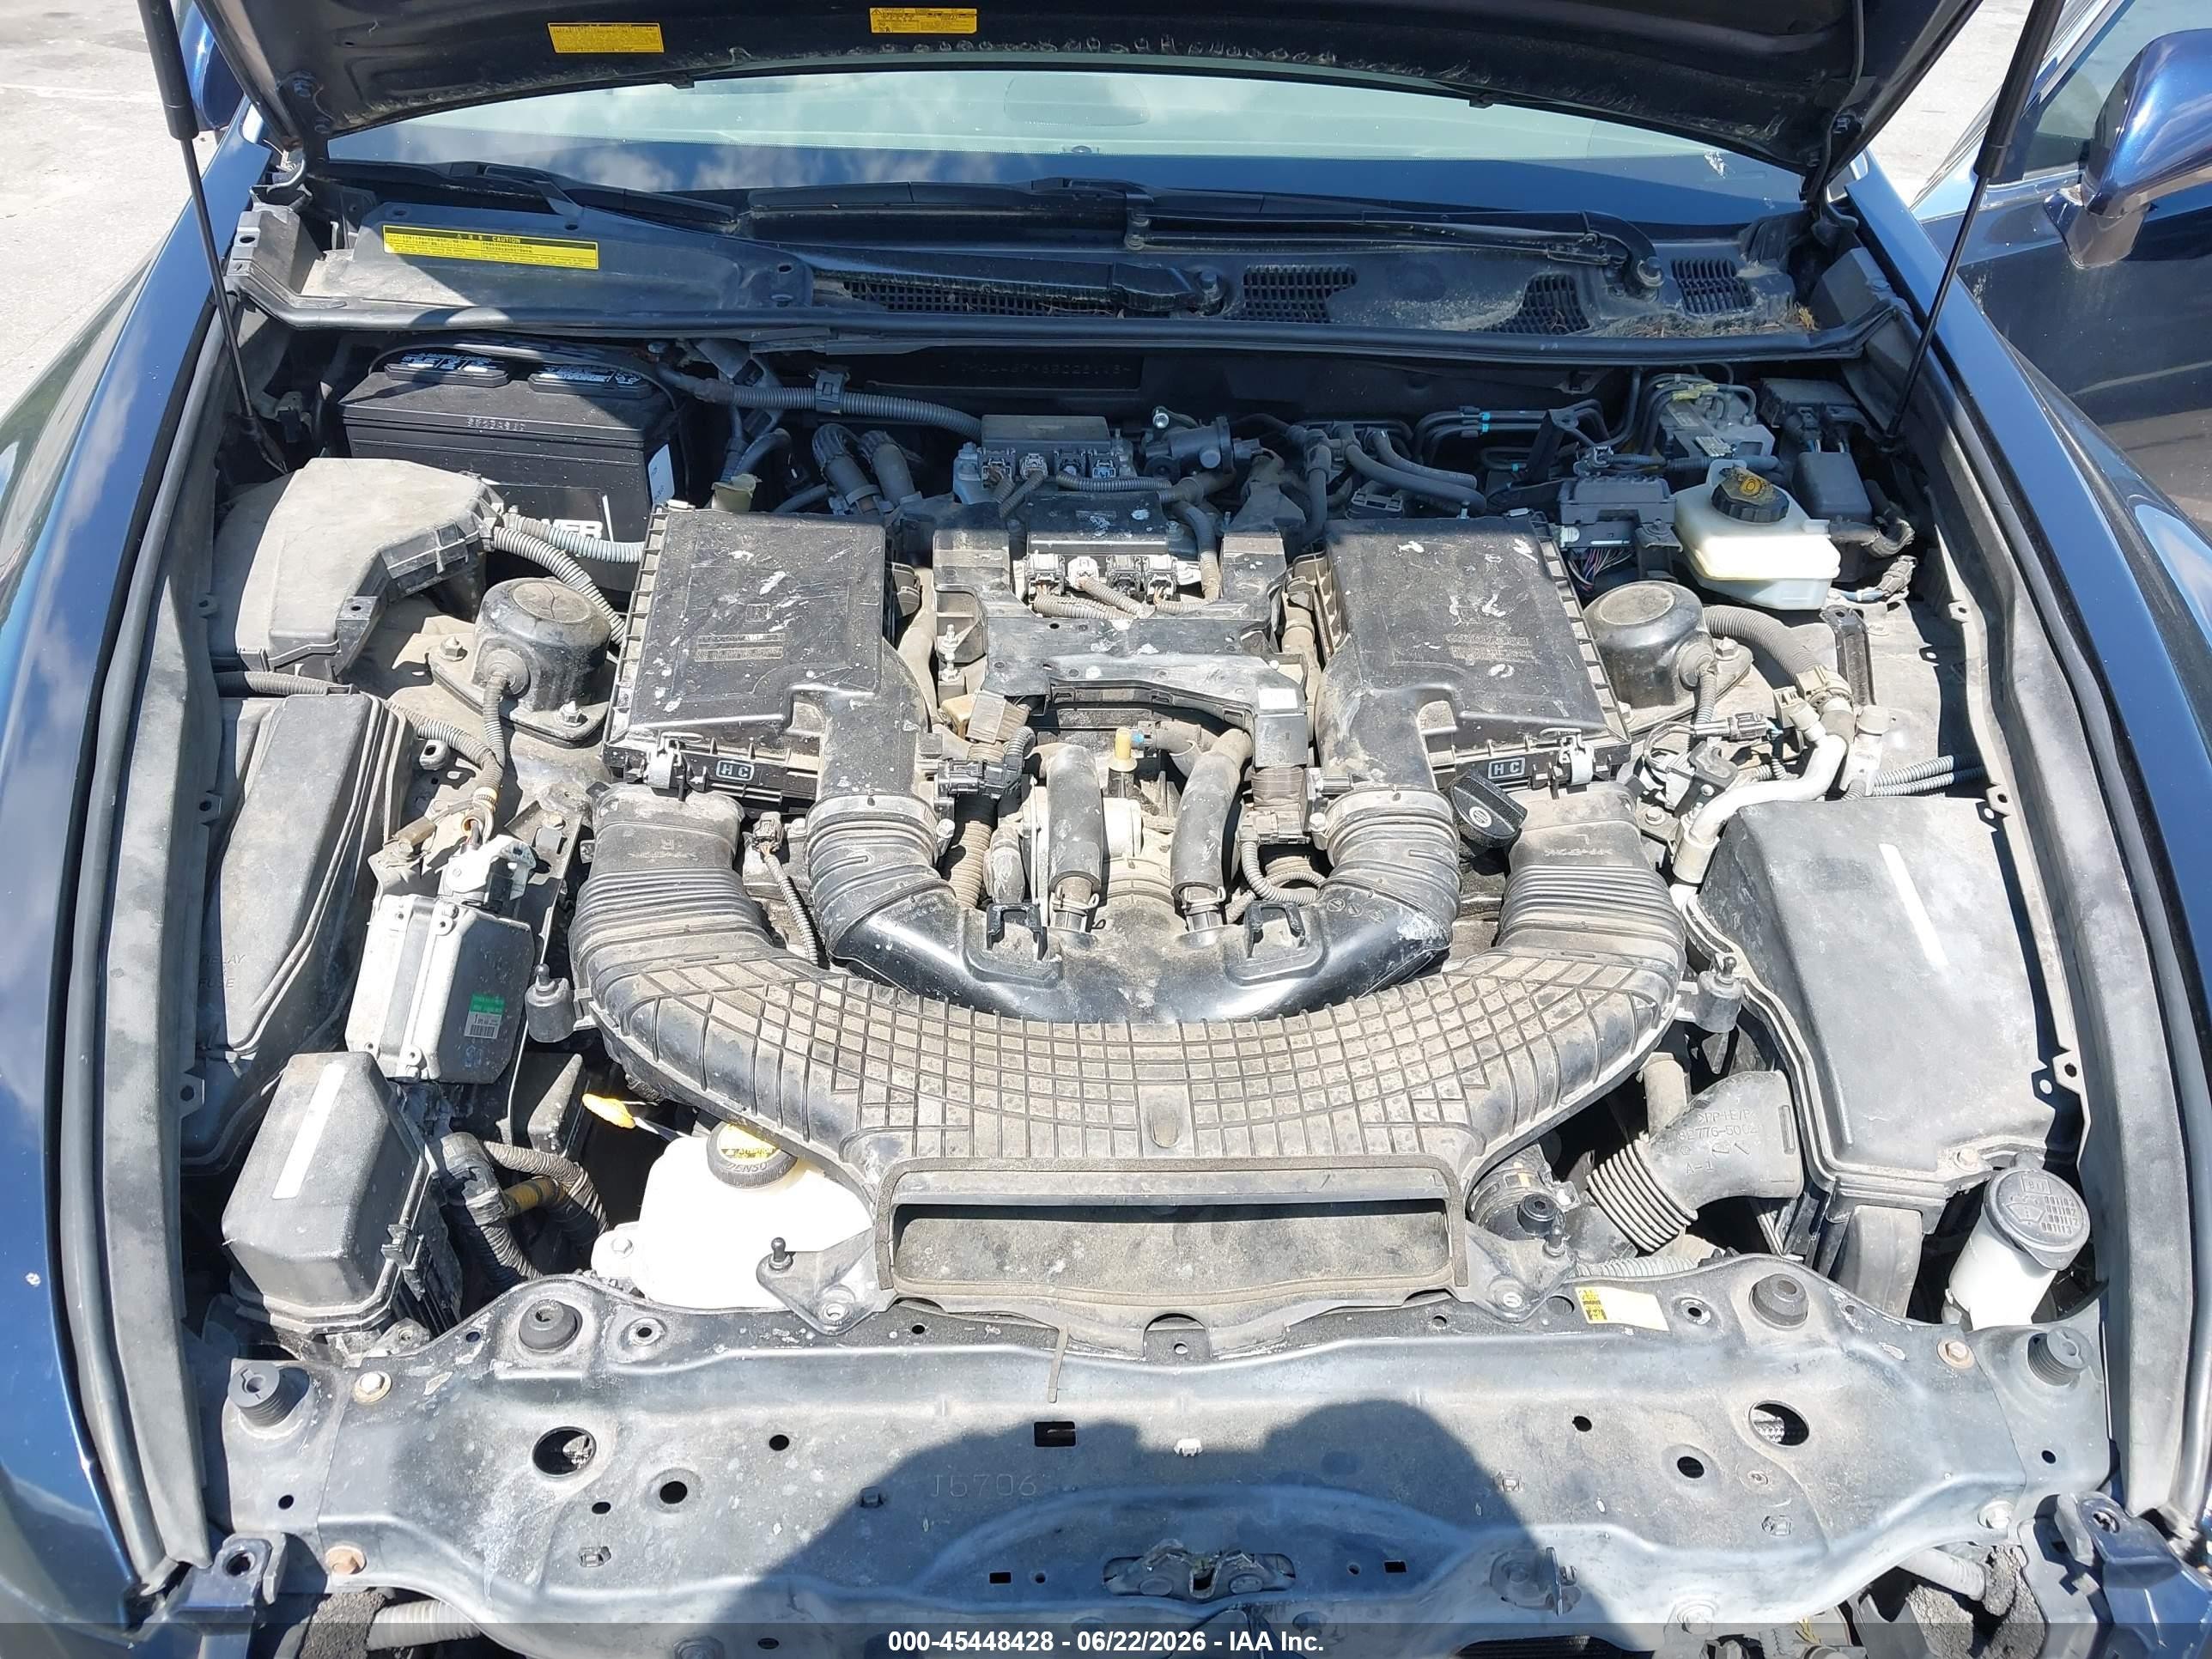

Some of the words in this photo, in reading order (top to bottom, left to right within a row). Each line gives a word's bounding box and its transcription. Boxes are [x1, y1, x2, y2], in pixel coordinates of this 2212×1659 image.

[492, 235, 521, 244] CAUTION
[726, 1162, 768, 1173] DENSO
[930, 1473, 1037, 1498] J5706
